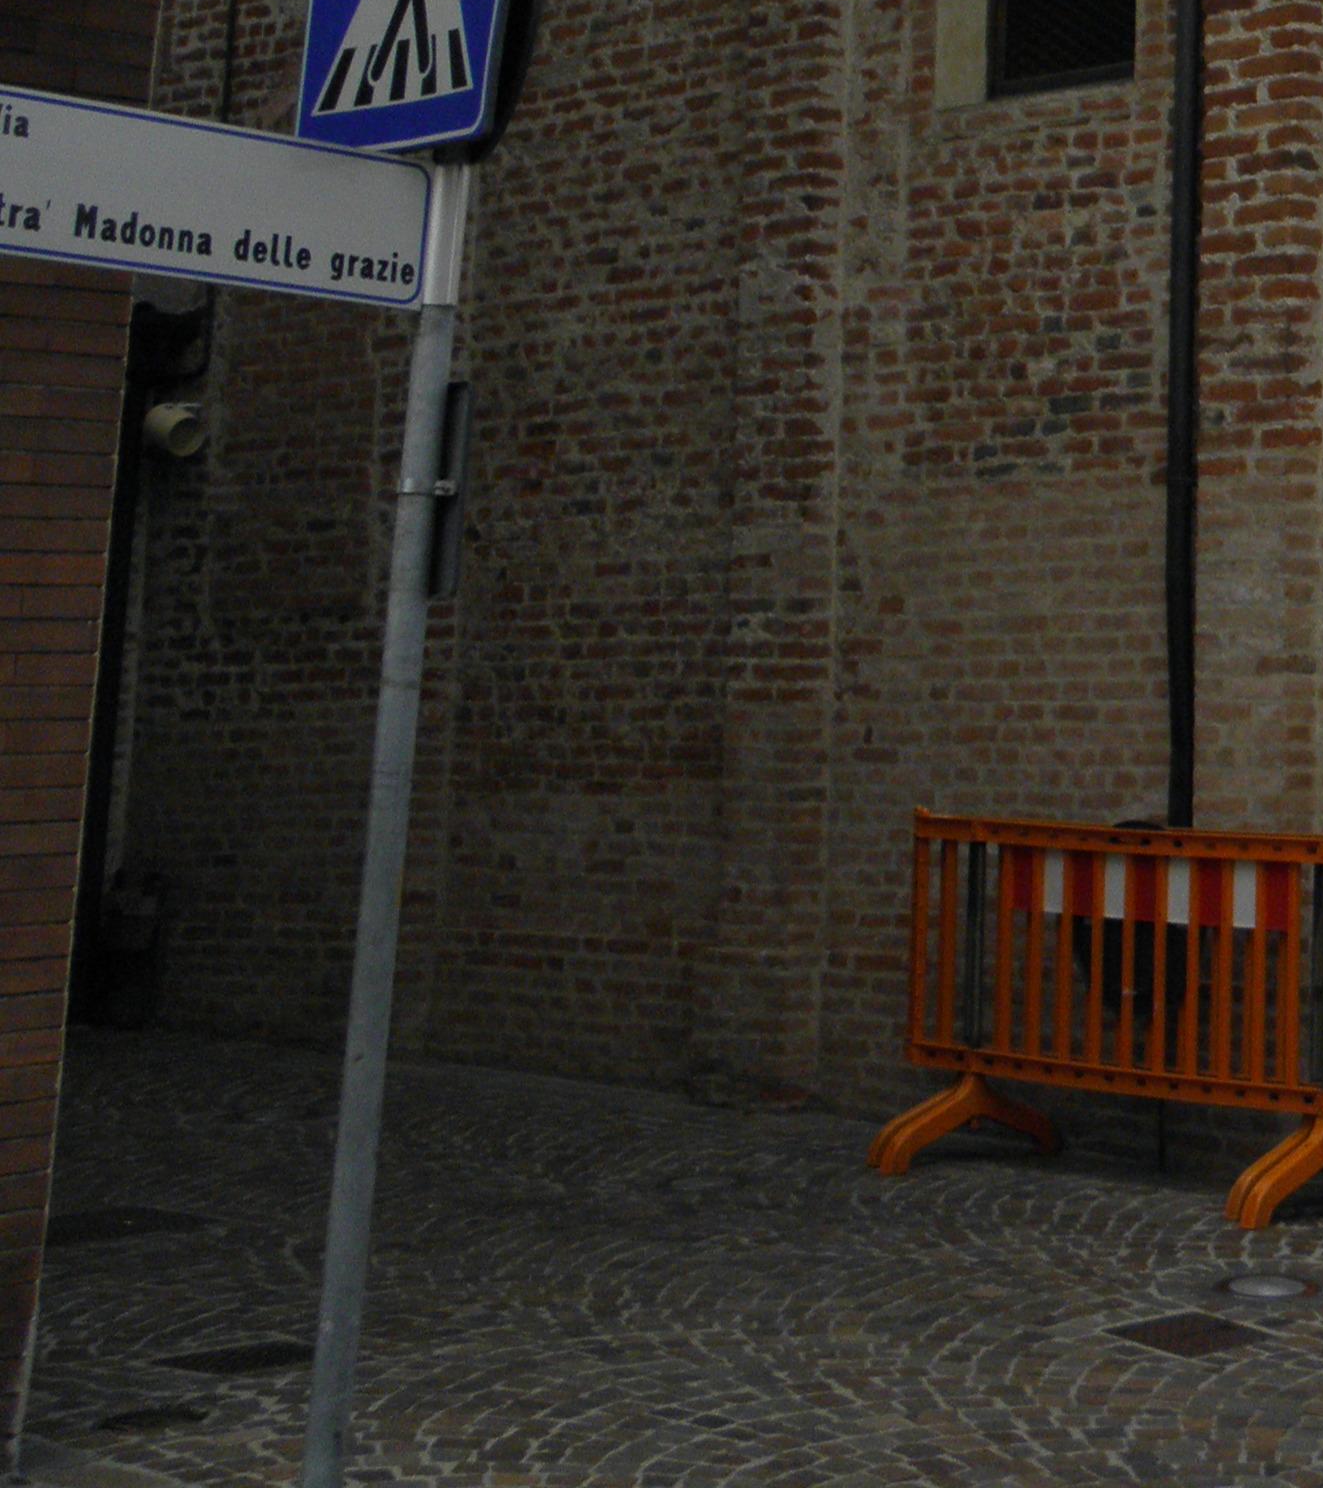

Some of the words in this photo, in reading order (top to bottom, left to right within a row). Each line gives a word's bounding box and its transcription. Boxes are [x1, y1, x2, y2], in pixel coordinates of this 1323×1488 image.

[0, 103, 29, 138] ia
[74, 203, 212, 255] Madonna
[234, 229, 311, 270] delle
[330, 252, 414, 285] grazie
